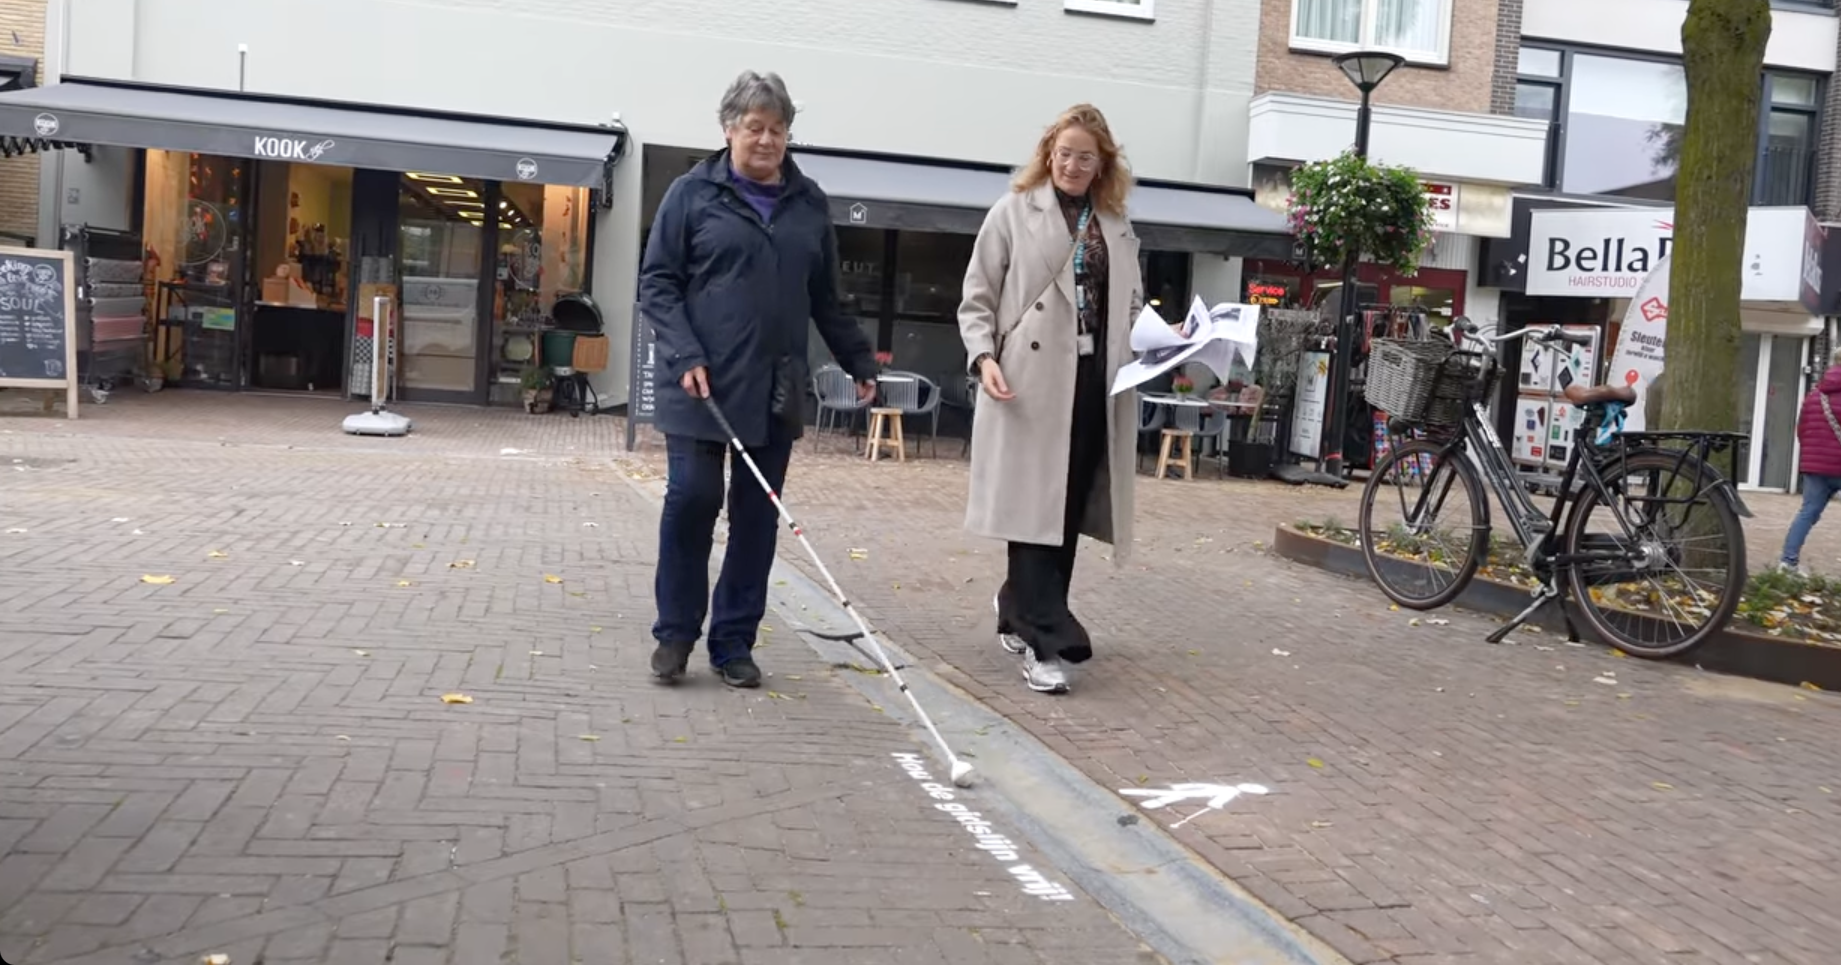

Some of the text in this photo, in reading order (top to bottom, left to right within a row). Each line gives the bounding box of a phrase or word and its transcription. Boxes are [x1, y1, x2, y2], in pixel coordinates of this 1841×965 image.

[254, 136, 307, 159] KOOK
[1248, 282, 1285, 297] Service
[1568, 275, 1638, 288] HAIRSTUDIO
[0, 296, 45, 314] SOUL
[891, 752, 1075, 900] Hou de gidslijn vrij!
